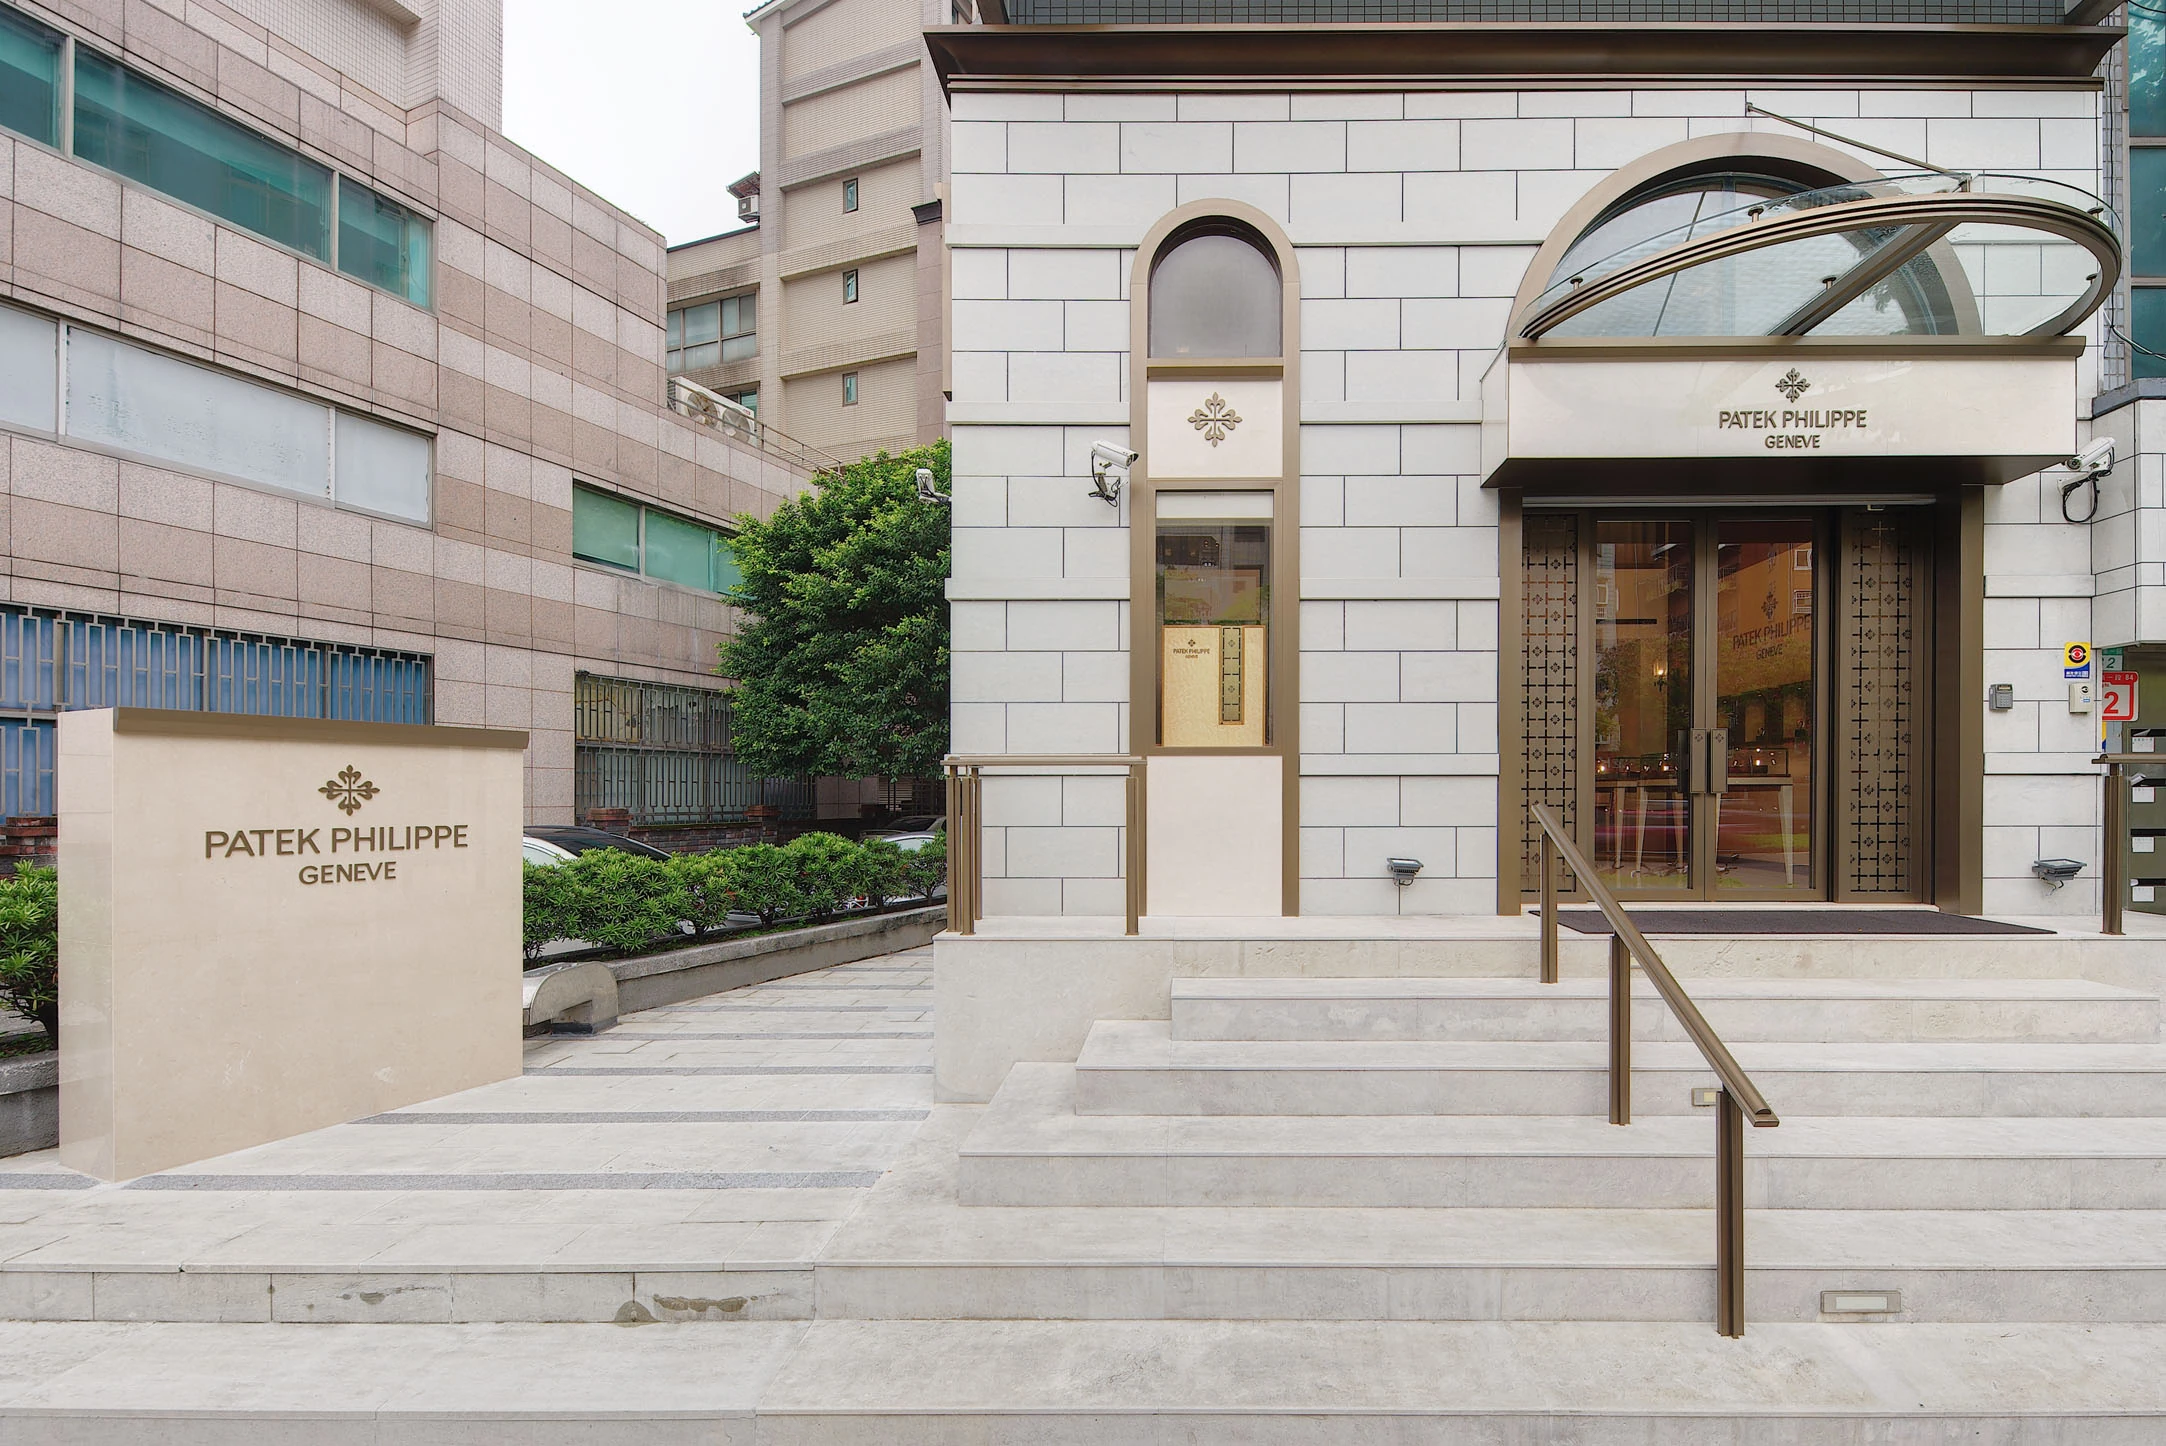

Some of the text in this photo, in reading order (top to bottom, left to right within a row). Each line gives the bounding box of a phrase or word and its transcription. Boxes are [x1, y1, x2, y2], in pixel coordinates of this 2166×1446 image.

[1719, 410, 1867, 429] PATEK PHILIPPE
[1765, 434, 1820, 449] GENEVE
[1733, 613, 1811, 650] PATEK PHILIPPE
[205, 824, 469, 858] PATEK PHILIPPE
[298, 861, 397, 884] GENEVE
